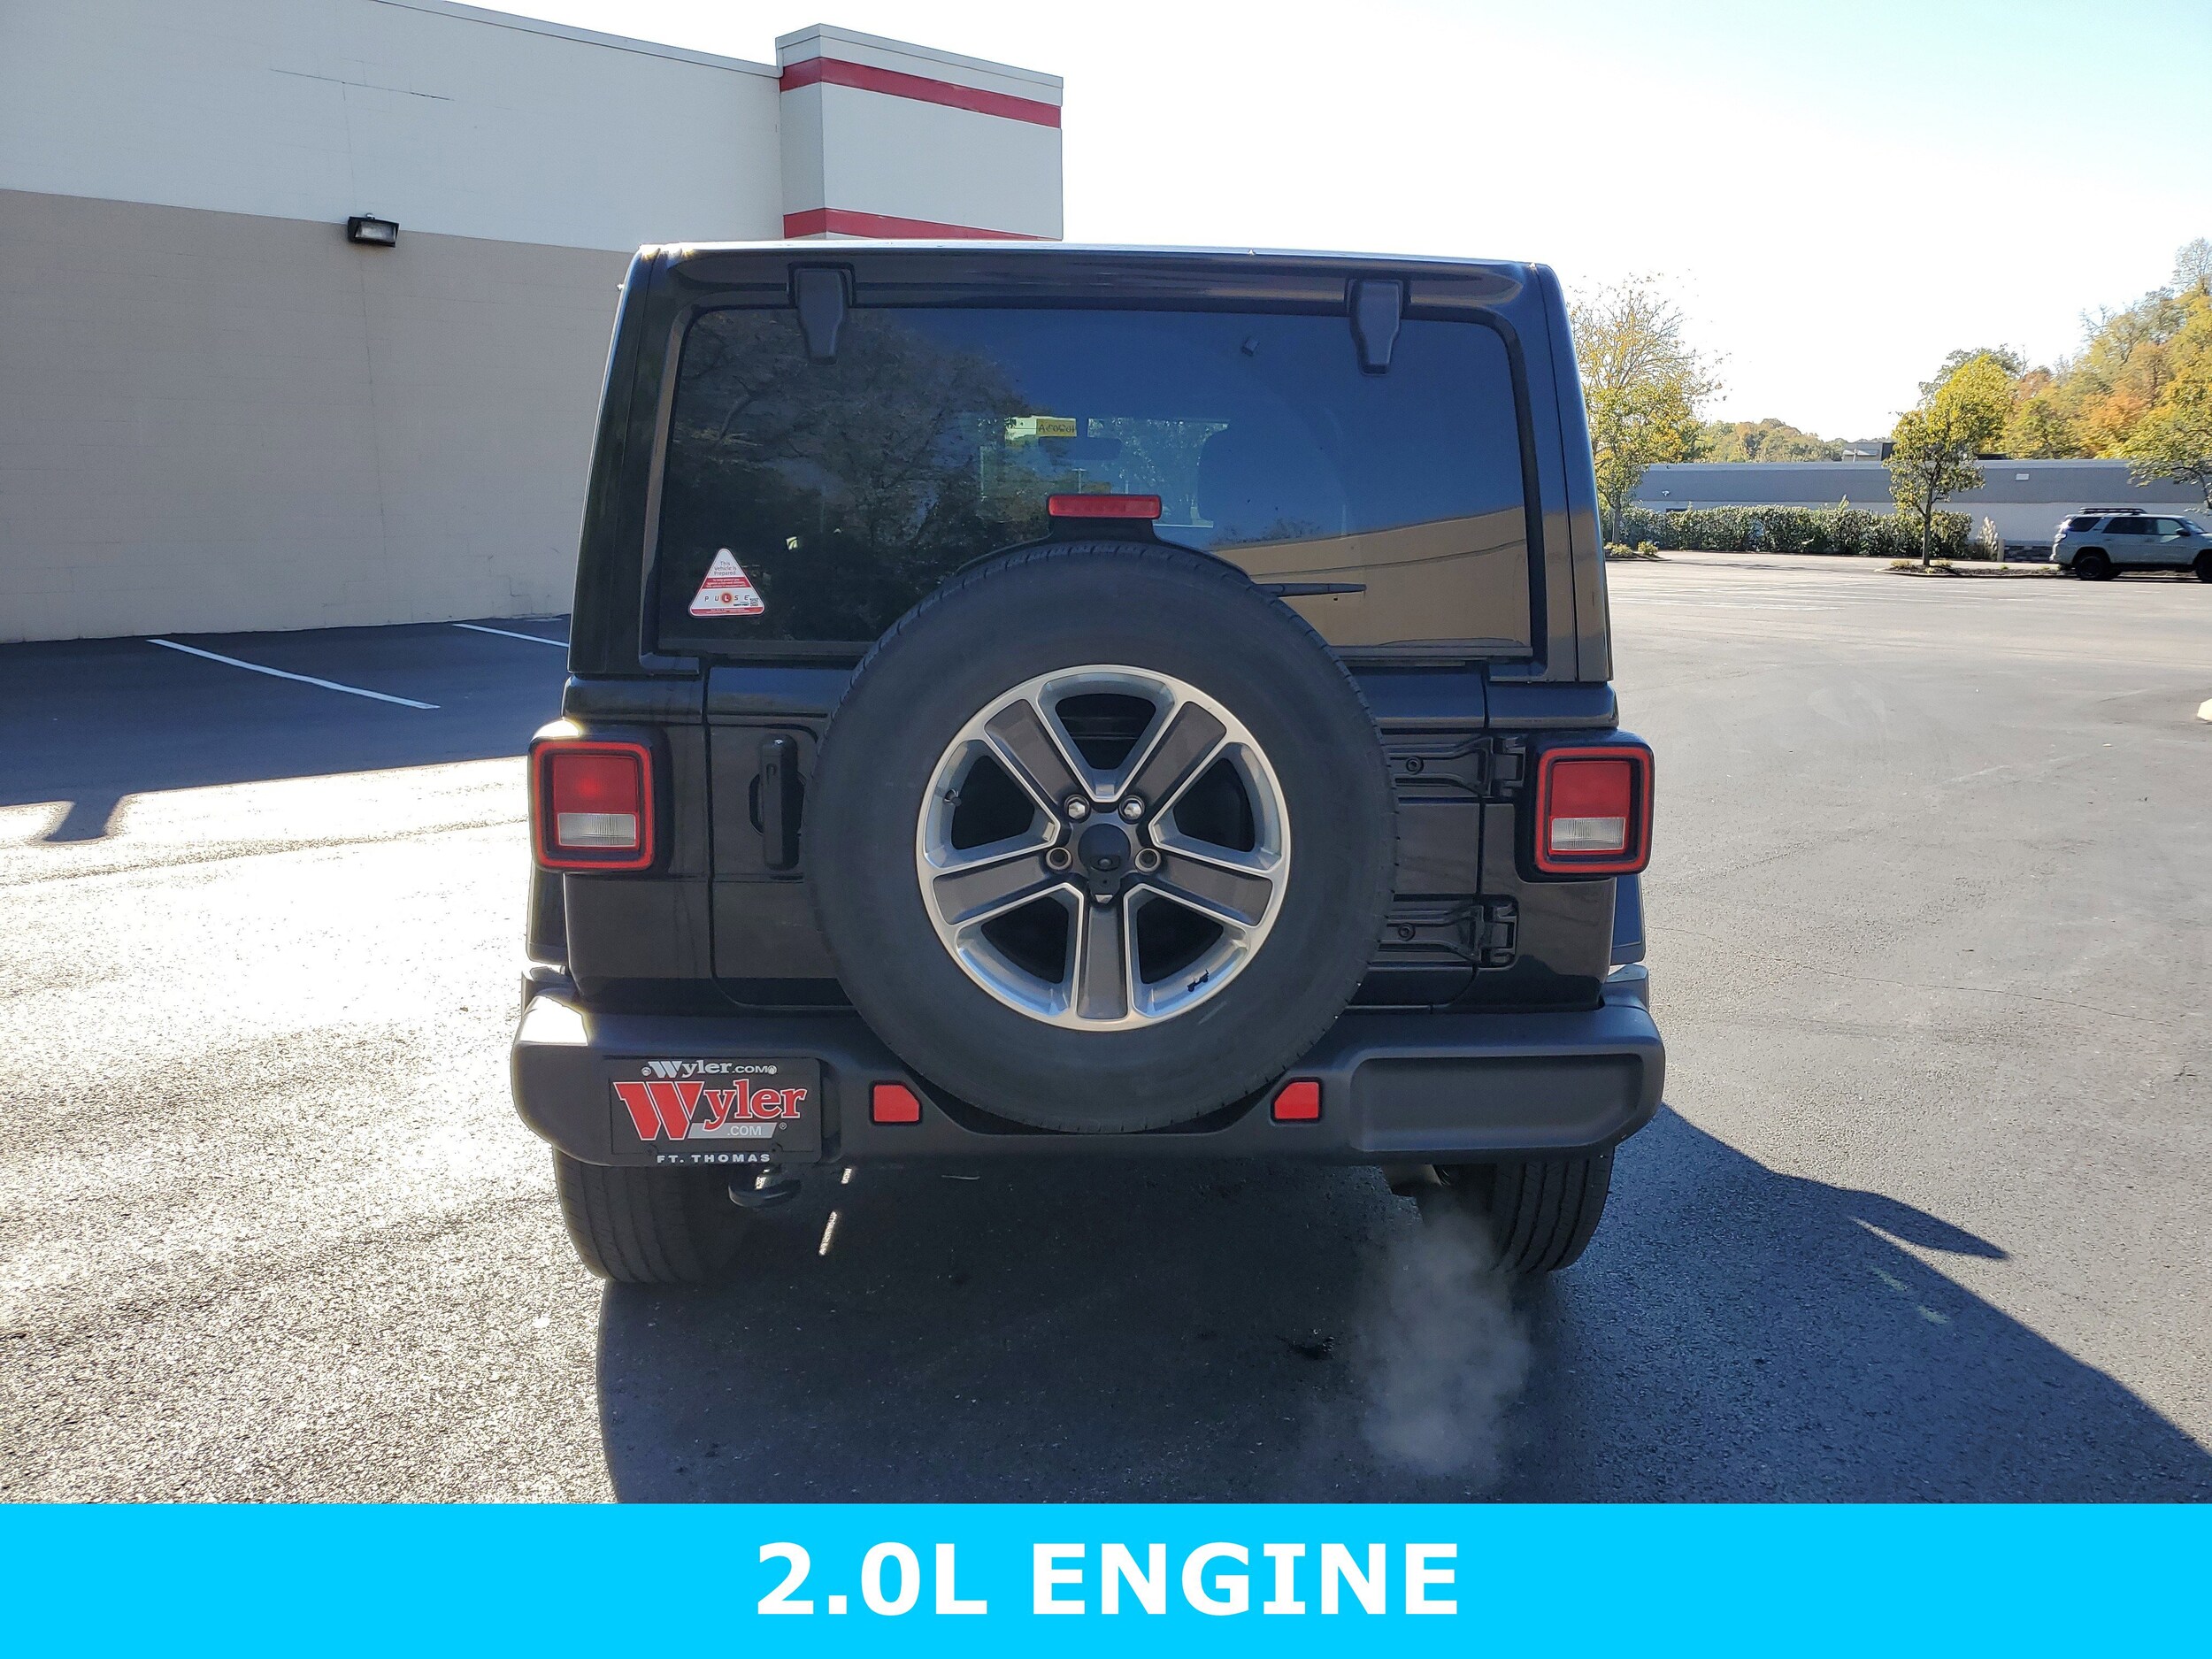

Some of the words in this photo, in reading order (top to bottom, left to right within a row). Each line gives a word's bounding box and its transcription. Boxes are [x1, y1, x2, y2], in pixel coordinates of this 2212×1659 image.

[613, 1079, 807, 1141] Wyler
[657, 1155, 684, 1164] FT.
[691, 1154, 770, 1163] THOMAS
